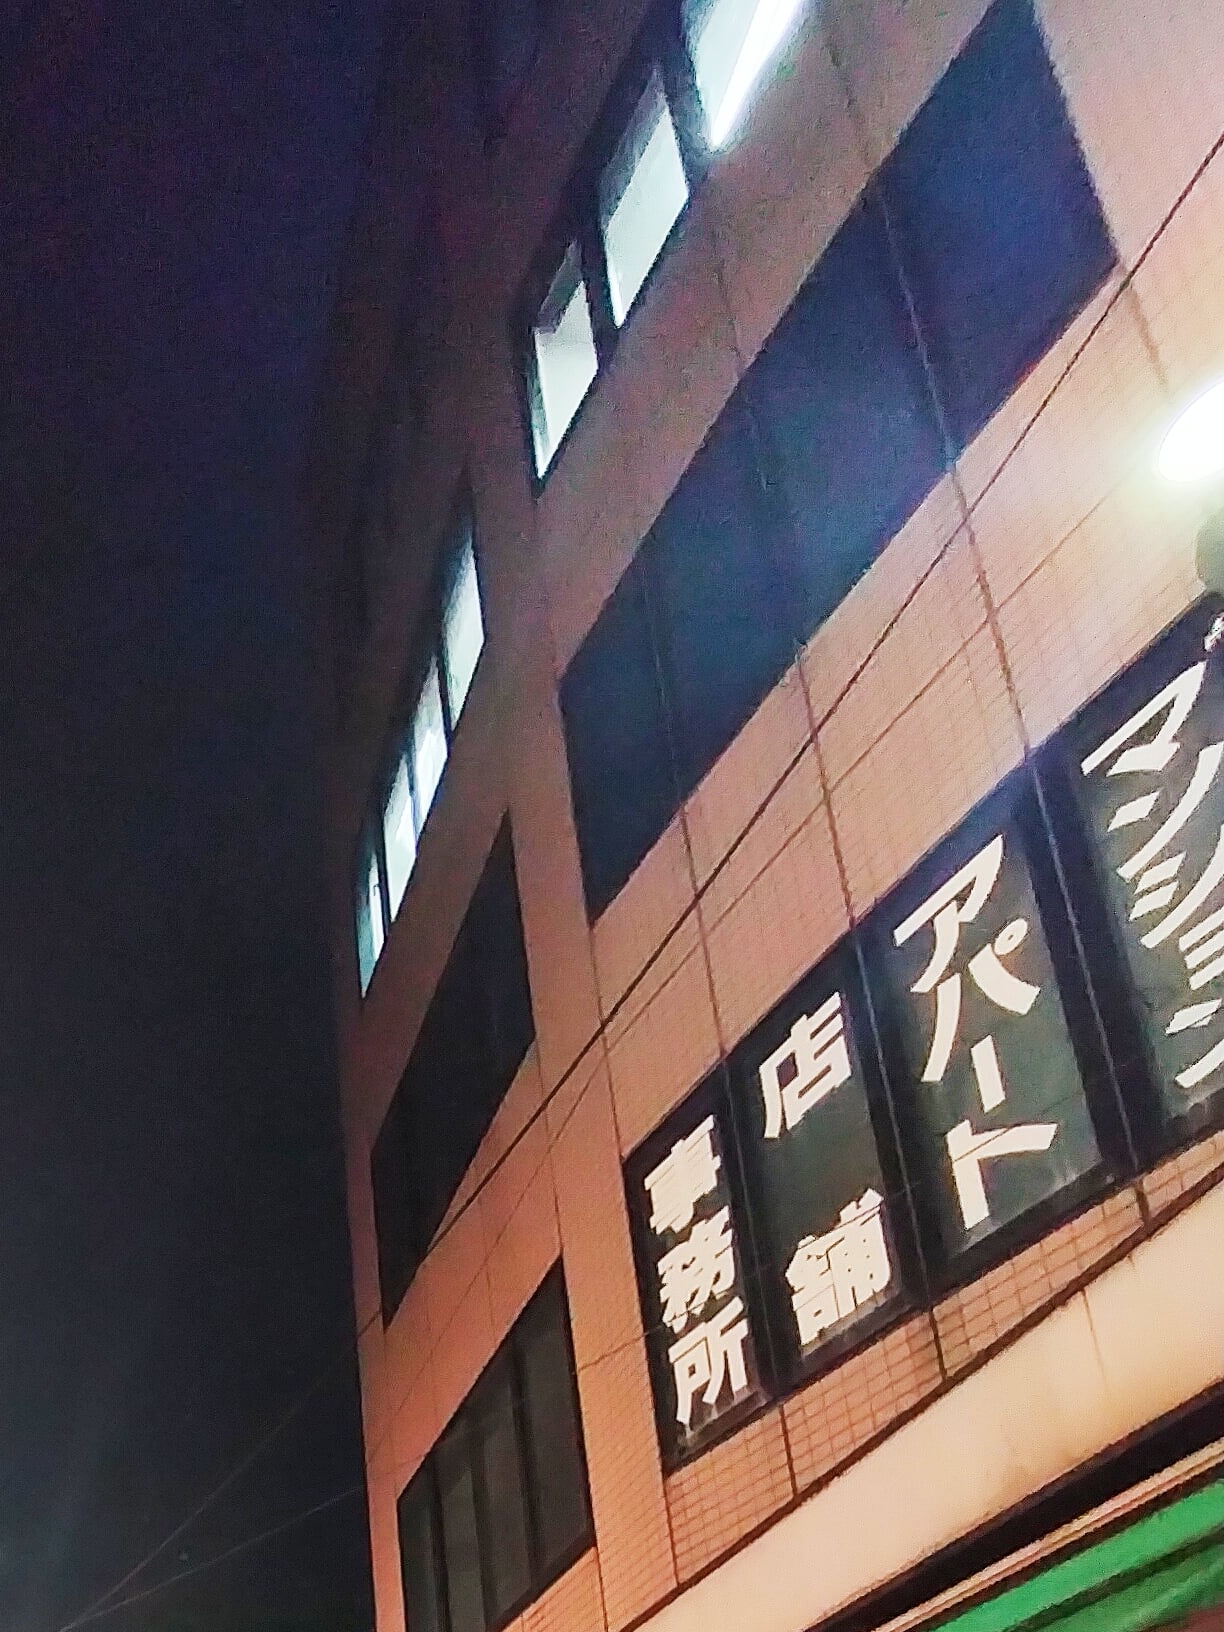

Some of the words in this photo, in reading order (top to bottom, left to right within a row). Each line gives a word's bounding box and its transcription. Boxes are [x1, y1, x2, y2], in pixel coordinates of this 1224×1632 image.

[760, 993, 893, 1349] 店舗
[894, 833, 1057, 1229] アパート
[644, 1114, 748, 1424] 事務所
